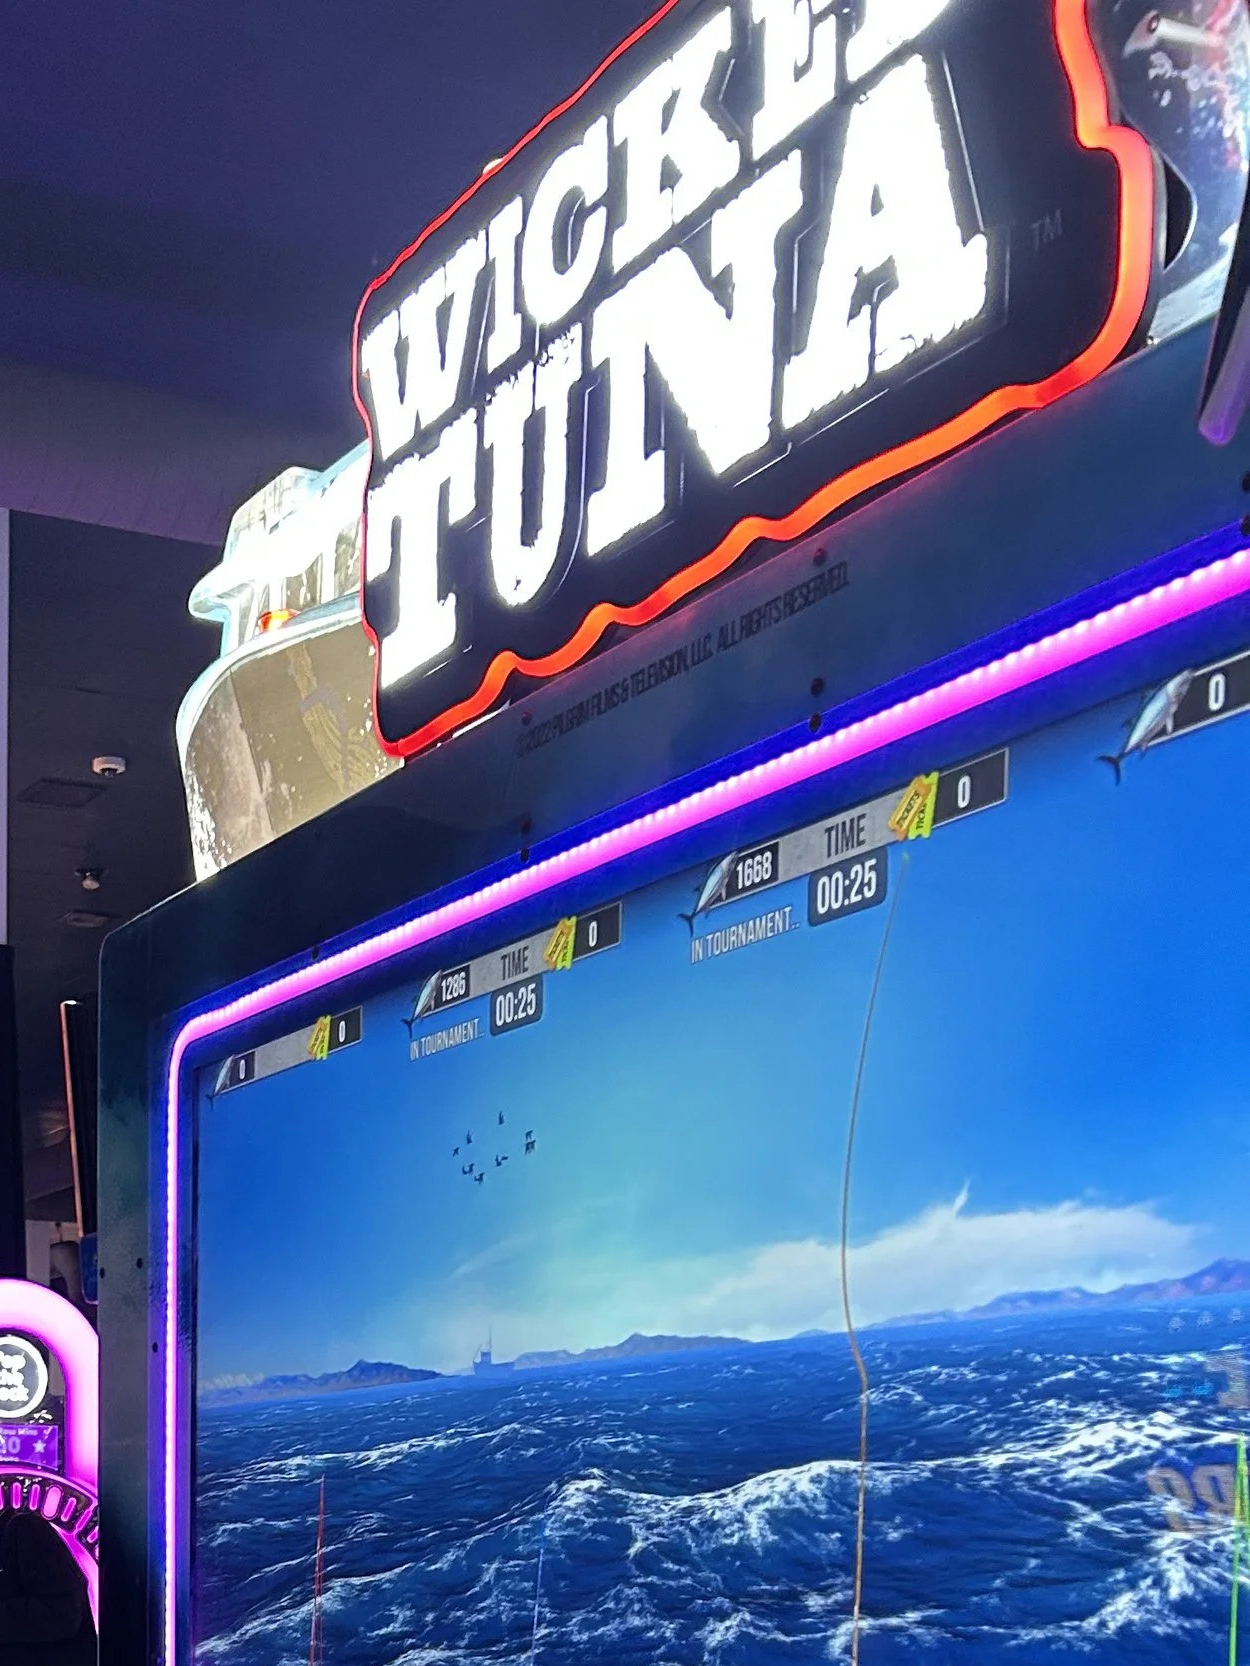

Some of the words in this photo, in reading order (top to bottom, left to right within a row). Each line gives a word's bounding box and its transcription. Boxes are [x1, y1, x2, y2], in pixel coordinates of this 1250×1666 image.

[366, 52, 988, 688] TUNA
[1208, 673, 1225, 711] 0
[736, 851, 772, 890] 1668
[824, 813, 867, 859] TIME
[957, 776, 971, 808] 0
[817, 858, 877, 915] 00:25
[441, 972, 466, 1002] 1286
[501, 945, 529, 981] TIME
[588, 921, 598, 947] 0
[691, 935, 705, 964] IN
[495, 983, 536, 1027] 00:25
[239, 1058, 246, 1080] 0
[338, 1020, 346, 1043] 0
[410, 1039, 419, 1061] IN
